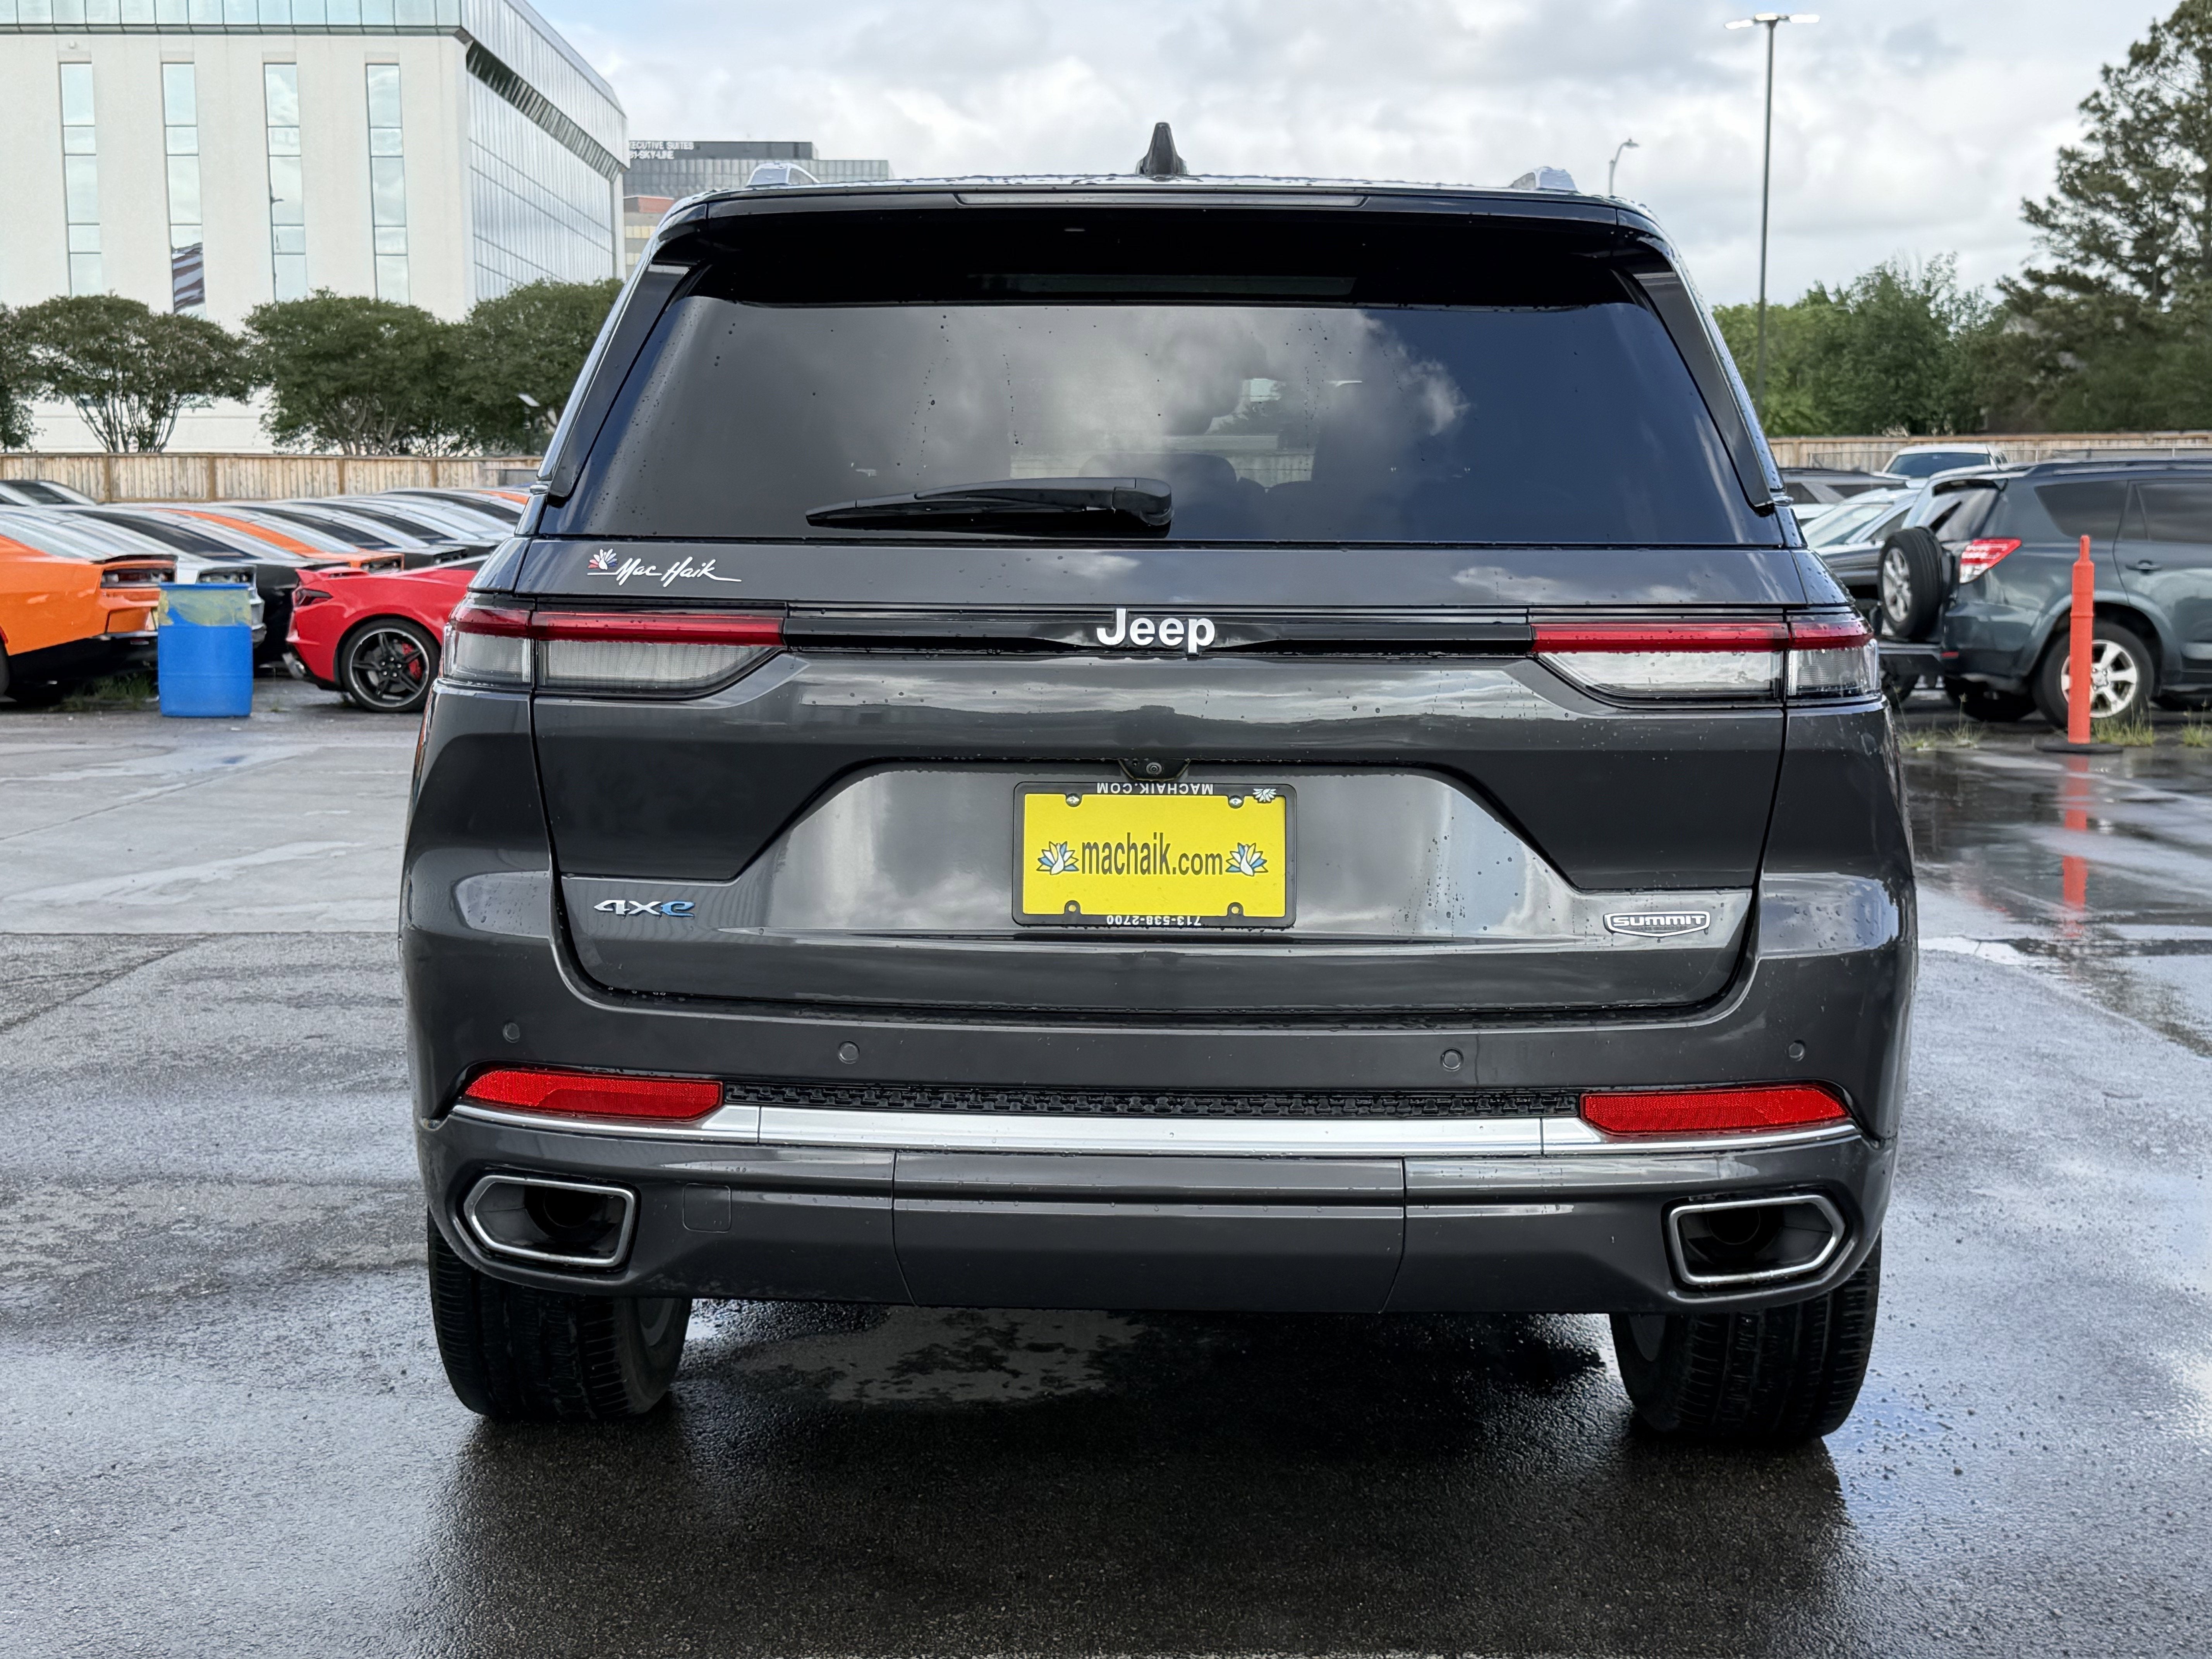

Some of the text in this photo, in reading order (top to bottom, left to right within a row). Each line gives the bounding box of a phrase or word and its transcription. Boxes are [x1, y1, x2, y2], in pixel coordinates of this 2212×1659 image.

[666, 142, 694, 150] SUITES
[587, 556, 742, 587] Mac Haik
[1097, 608, 1215, 653] Jeep
[1096, 782, 1214, 795] MACHAIK.COM
[1082, 832, 1223, 875] machaik.com
[1106, 915, 1202, 926] 713-538-2700
[1613, 915, 1705, 926] SUMMIT
